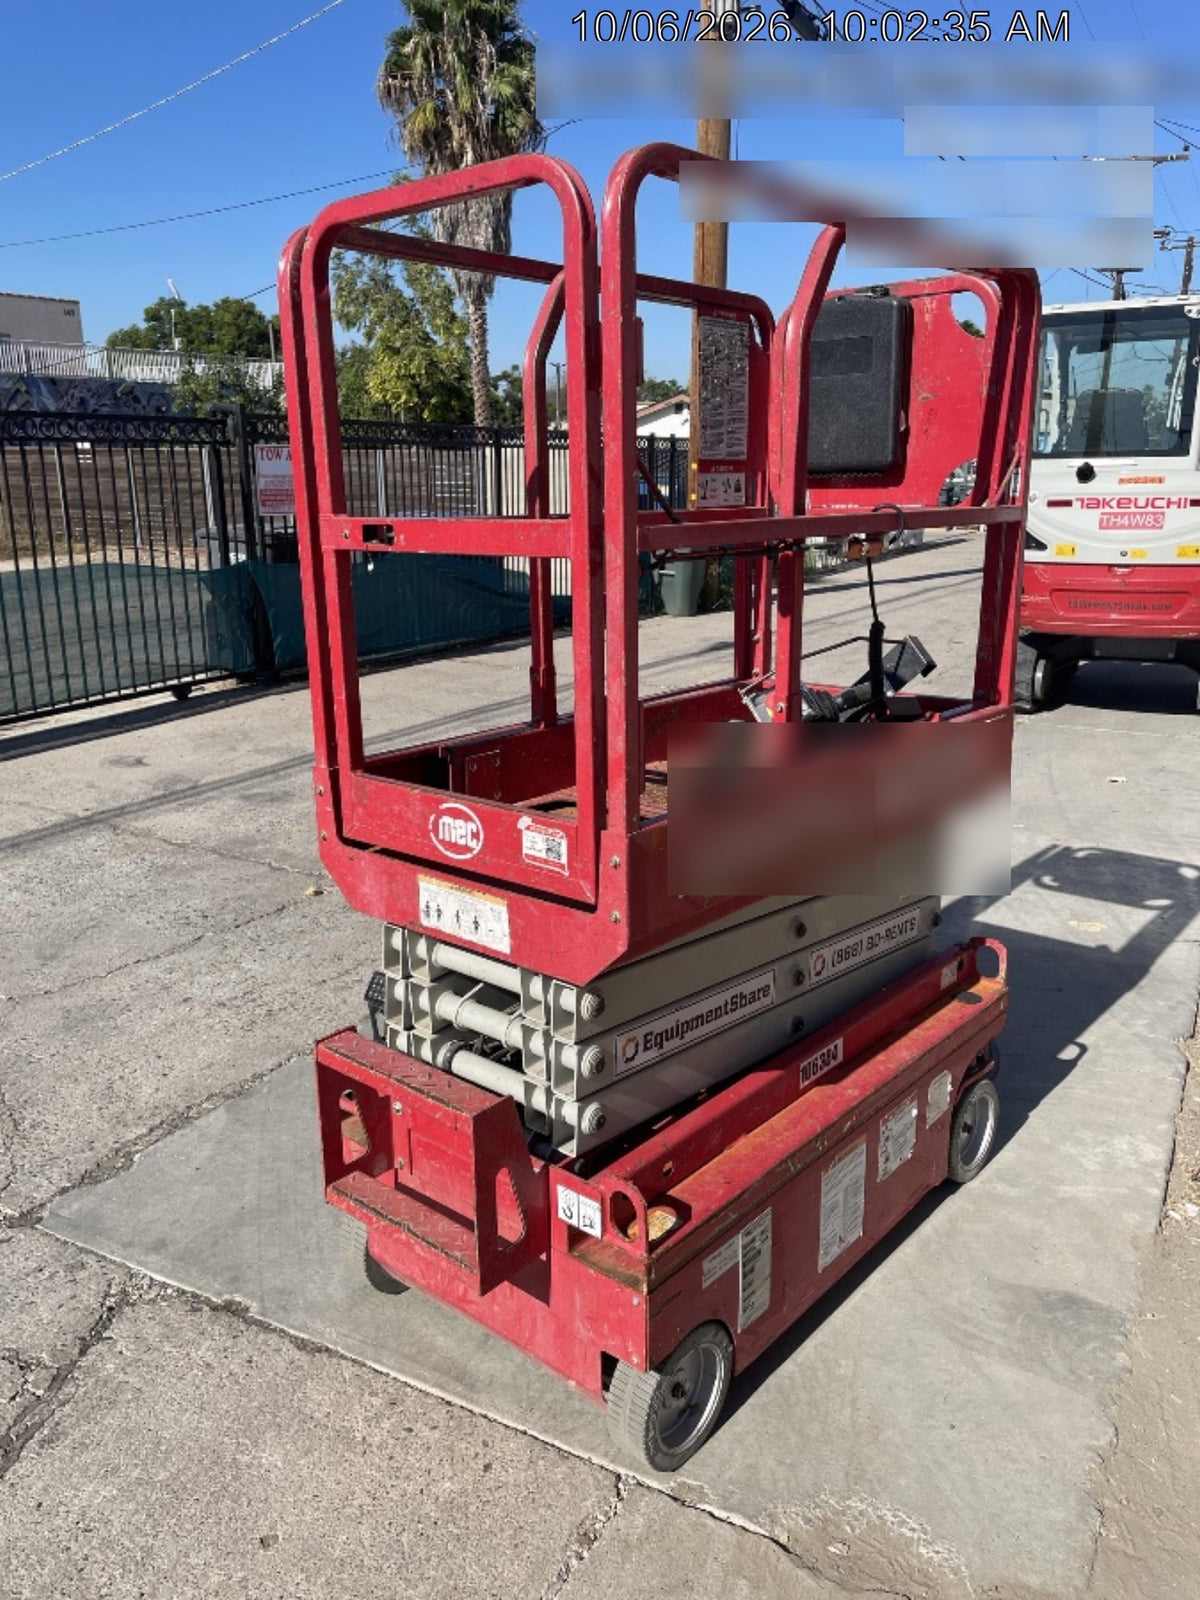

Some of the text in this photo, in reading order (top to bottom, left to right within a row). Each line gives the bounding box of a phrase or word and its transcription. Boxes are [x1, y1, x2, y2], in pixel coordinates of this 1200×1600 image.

[259, 447, 284, 461] TOW
[1075, 497, 1189, 509] TAKEUCHI
[642, 983, 771, 1053] EquipmentShare
